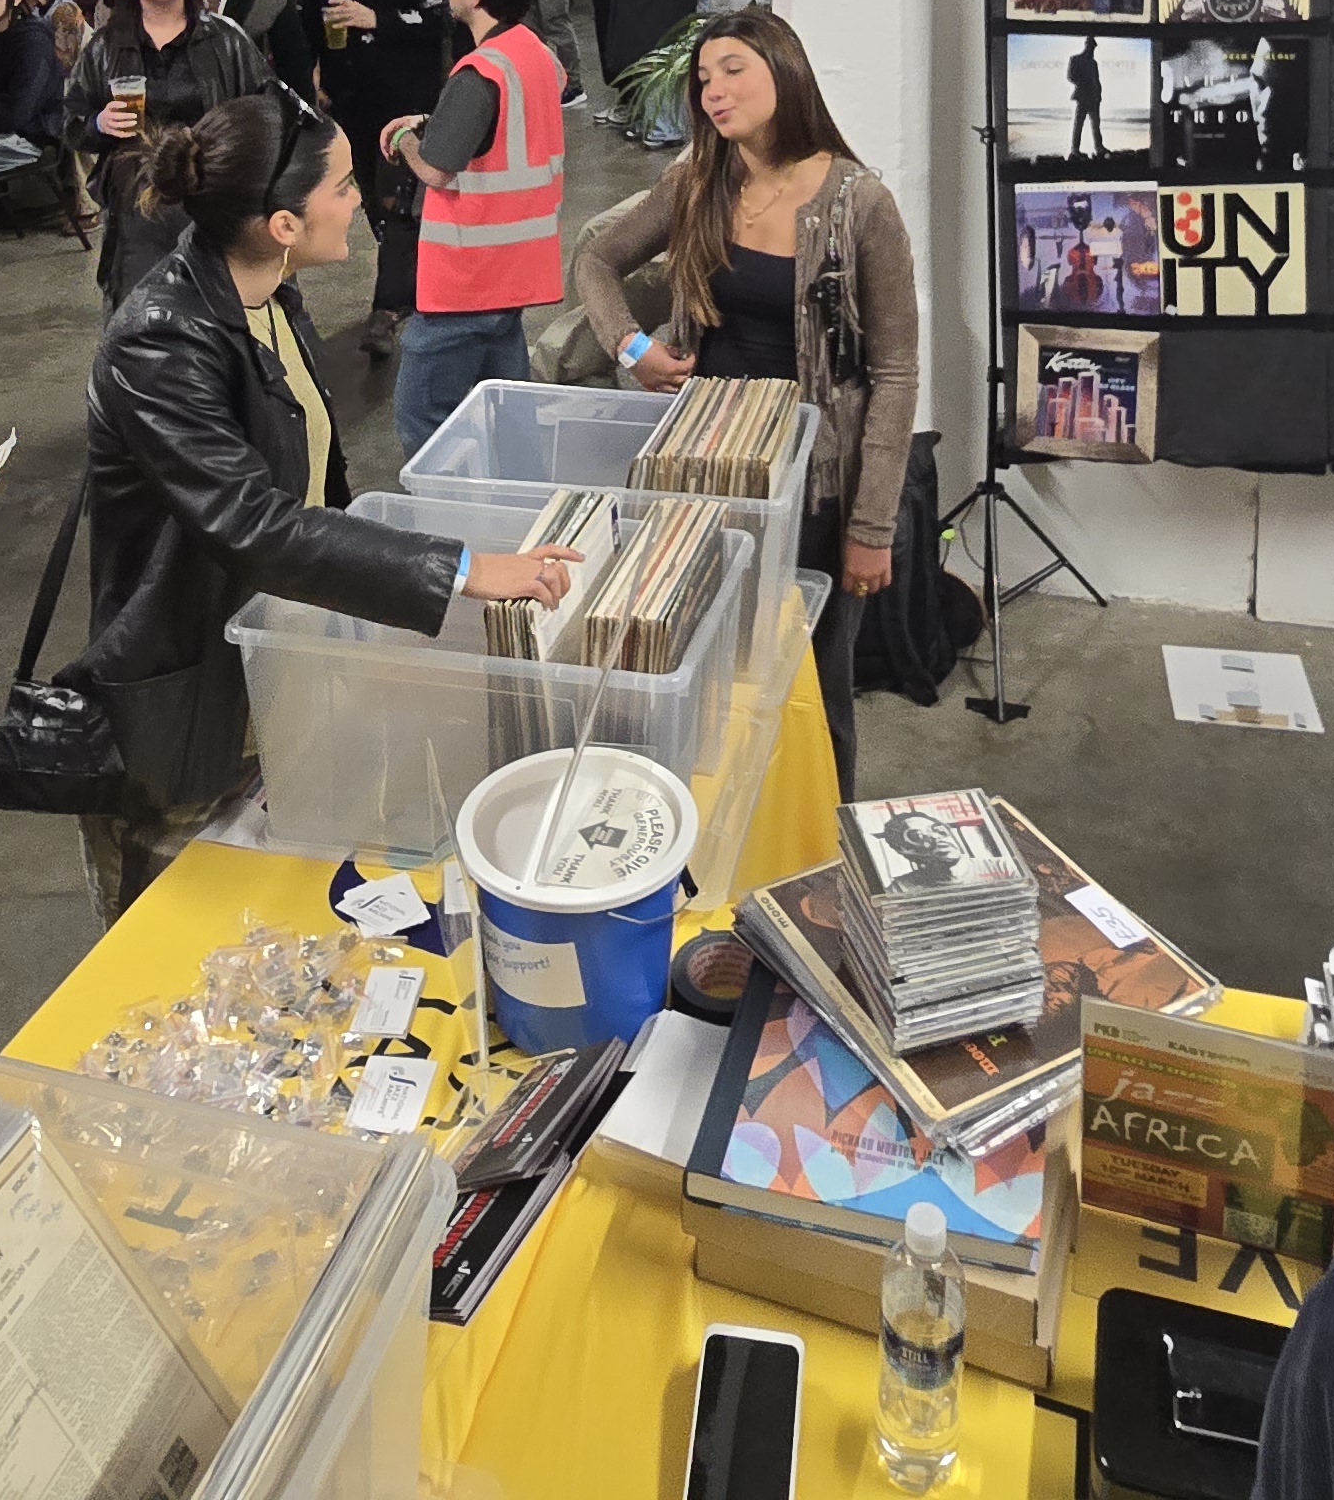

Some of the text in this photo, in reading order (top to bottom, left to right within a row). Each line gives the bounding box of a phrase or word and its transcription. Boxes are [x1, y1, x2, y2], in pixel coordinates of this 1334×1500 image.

[1169, 109, 1249, 124] TRIO
[1159, 192, 1290, 257] UN
[609, 811, 648, 868] GENEROUSLY
[613, 808, 665, 879] PLEASE GIVE
[553, 857, 570, 876] YOU
[560, 853, 586, 884] THANK
[760, 896, 789, 929] mono
[392, 1085, 410, 1121] NATIONAL
[1090, 1104, 1261, 1168] AFRICA
[1109, 1153, 1181, 1177] TUESDAY
[1134, 1171, 1190, 1193] MARCH
